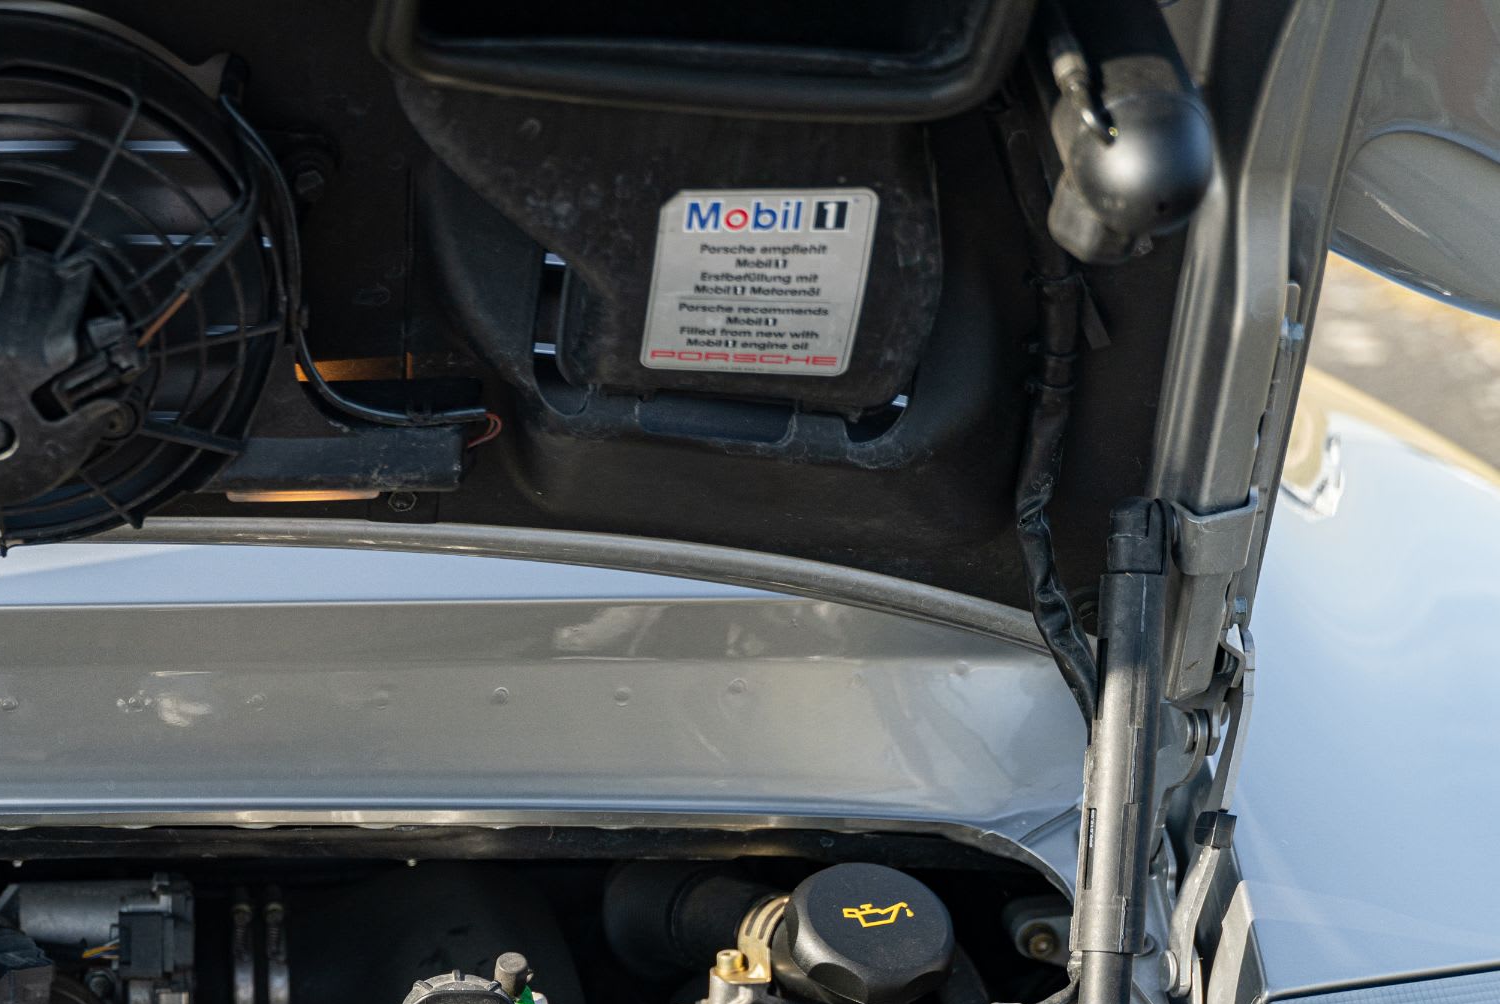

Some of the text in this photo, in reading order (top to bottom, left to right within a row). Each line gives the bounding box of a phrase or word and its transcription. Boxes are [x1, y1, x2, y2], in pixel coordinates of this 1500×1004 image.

[686, 201, 844, 230] Mobil 1
[700, 244, 755, 254] Porsche
[736, 259, 772, 268] Mobil
[701, 272, 818, 285] Erstbefüllung mit
[694, 285, 730, 295] Mobil
[750, 287, 820, 296] Motorenöl
[679, 303, 828, 316] Porsche recommends
[726, 316, 762, 326] Mobil
[680, 326, 716, 336] Filled
[720, 328, 752, 337] from
[790, 330, 819, 339] with
[687, 338, 722, 347] Mobil
[741, 341, 788, 351] engine
[792, 341, 808, 350] oil
[650, 350, 837, 366] PORSCHE
